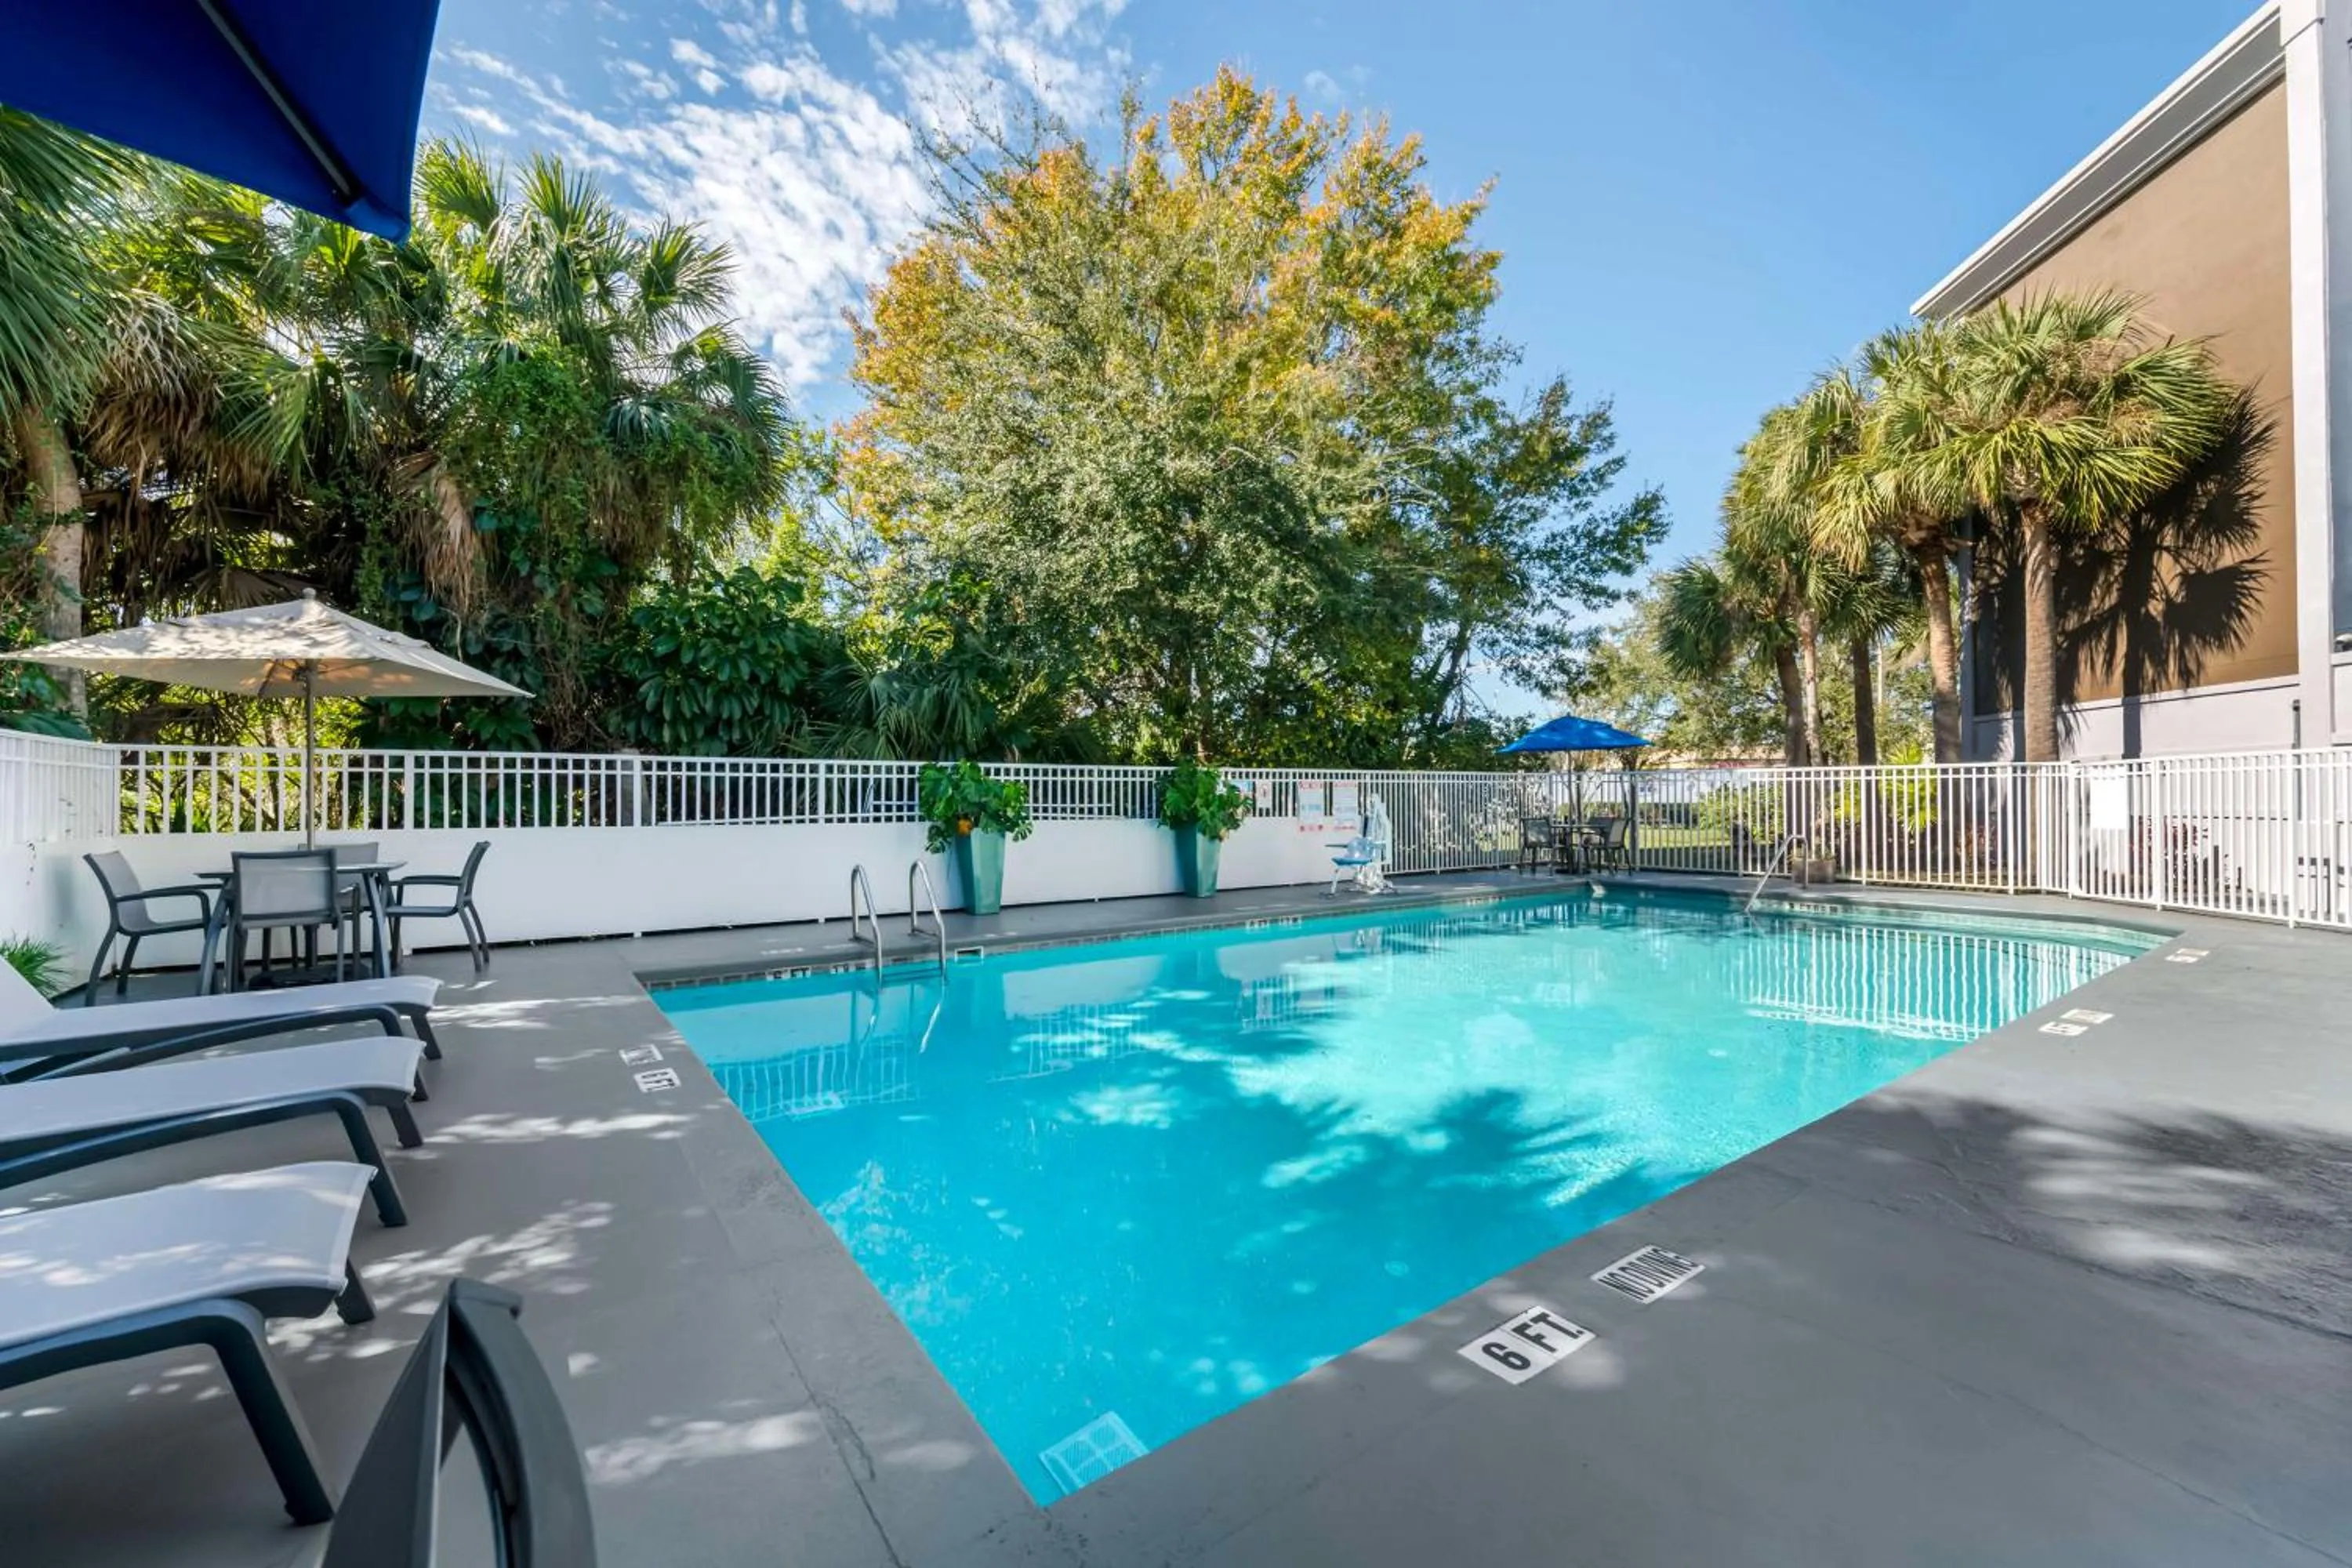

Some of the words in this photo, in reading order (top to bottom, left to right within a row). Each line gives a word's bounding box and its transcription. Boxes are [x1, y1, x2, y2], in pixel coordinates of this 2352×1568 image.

[1597, 1271, 1655, 1301] NO
[1617, 1247, 1699, 1288] DIVING
[1482, 1342, 1531, 1370] 6
[1511, 1312, 1584, 1353] FT.
